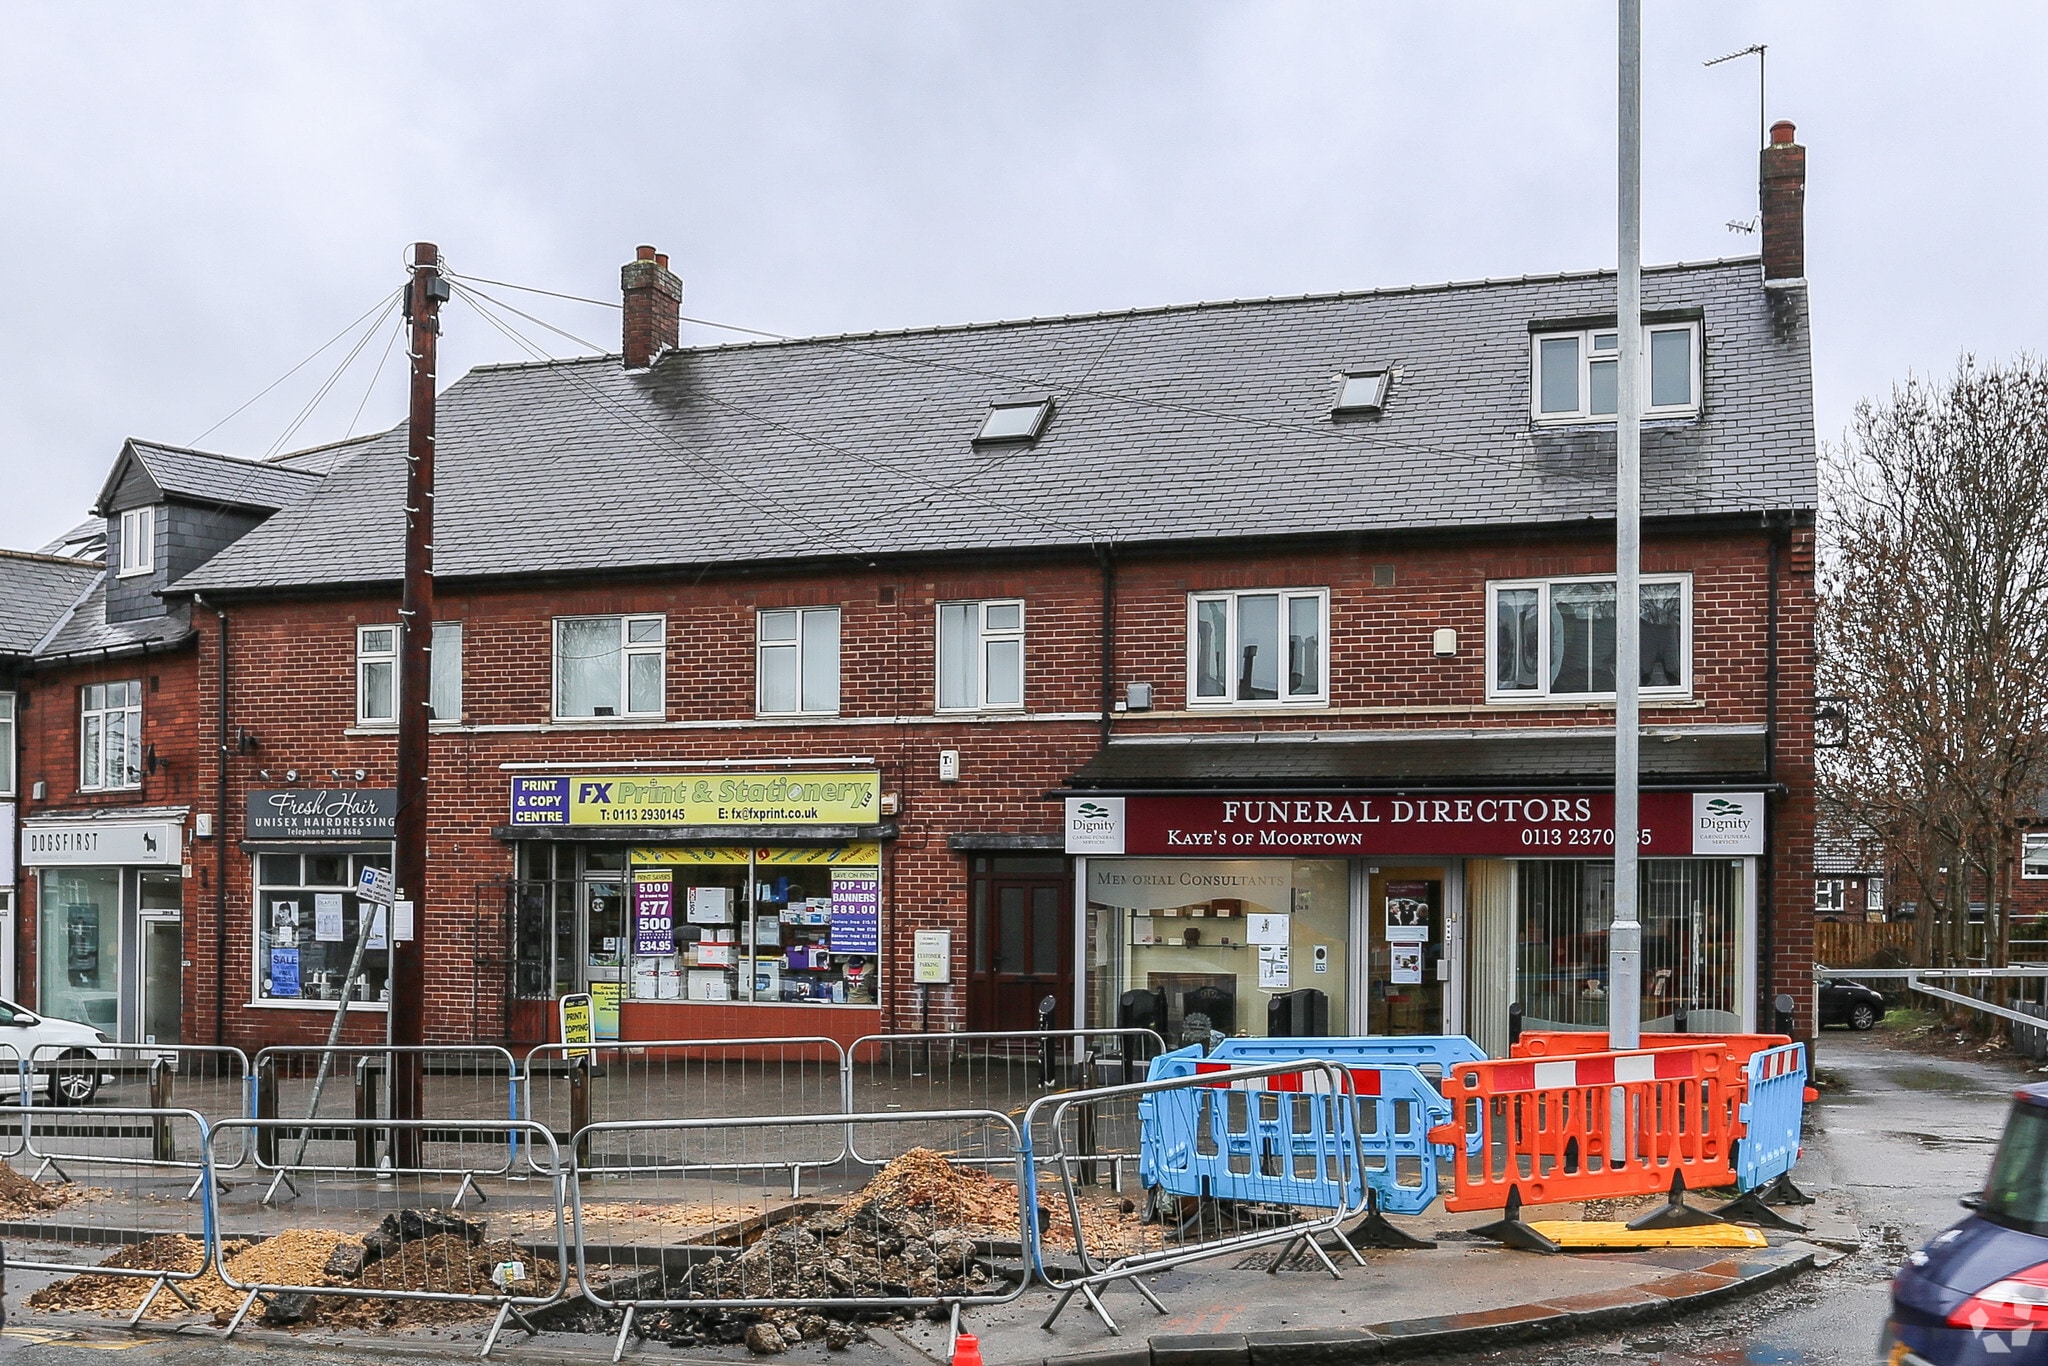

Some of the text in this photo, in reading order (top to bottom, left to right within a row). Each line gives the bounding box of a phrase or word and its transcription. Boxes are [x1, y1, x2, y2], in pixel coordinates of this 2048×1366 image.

[522, 780, 557, 791] PRINT
[578, 776, 873, 808] FX Print & Stationery Ltd
[268, 790, 379, 817] Fresh Hair
[517, 796, 562, 807] & COPY
[516, 811, 563, 822] CENTRE
[600, 808, 685, 821] T: 0113 2930145
[718, 807, 818, 821] E: fx@fxprint.co.uk
[1222, 799, 1591, 823] FUNERAL DIRECTORS
[255, 817, 395, 827] UNISEX HAIRDRESSING
[1073, 819, 1115, 833] Dignity
[1700, 817, 1751, 832] Dignity
[287, 828, 325, 836] Telephone
[327, 828, 341, 836] 288
[1167, 830, 1363, 845] KAYE'S OF MOORTOWN
[1521, 829, 1651, 845] 0113 23705
[31, 833, 98, 852] DOGSFIRST
[1180, 872, 1284, 886] CONSULTANTS
[639, 883, 668, 893] 5000
[832, 881, 876, 891] POP-UP
[832, 893, 876, 903] BANNERS
[640, 901, 669, 916] £77
[832, 905, 876, 914] £89.00
[639, 918, 671, 930] 500
[640, 941, 671, 951] £34.95
[273, 955, 298, 965] SALE
[567, 1012, 582, 1020] PRINT
[566, 1024, 588, 1033] COPYING
